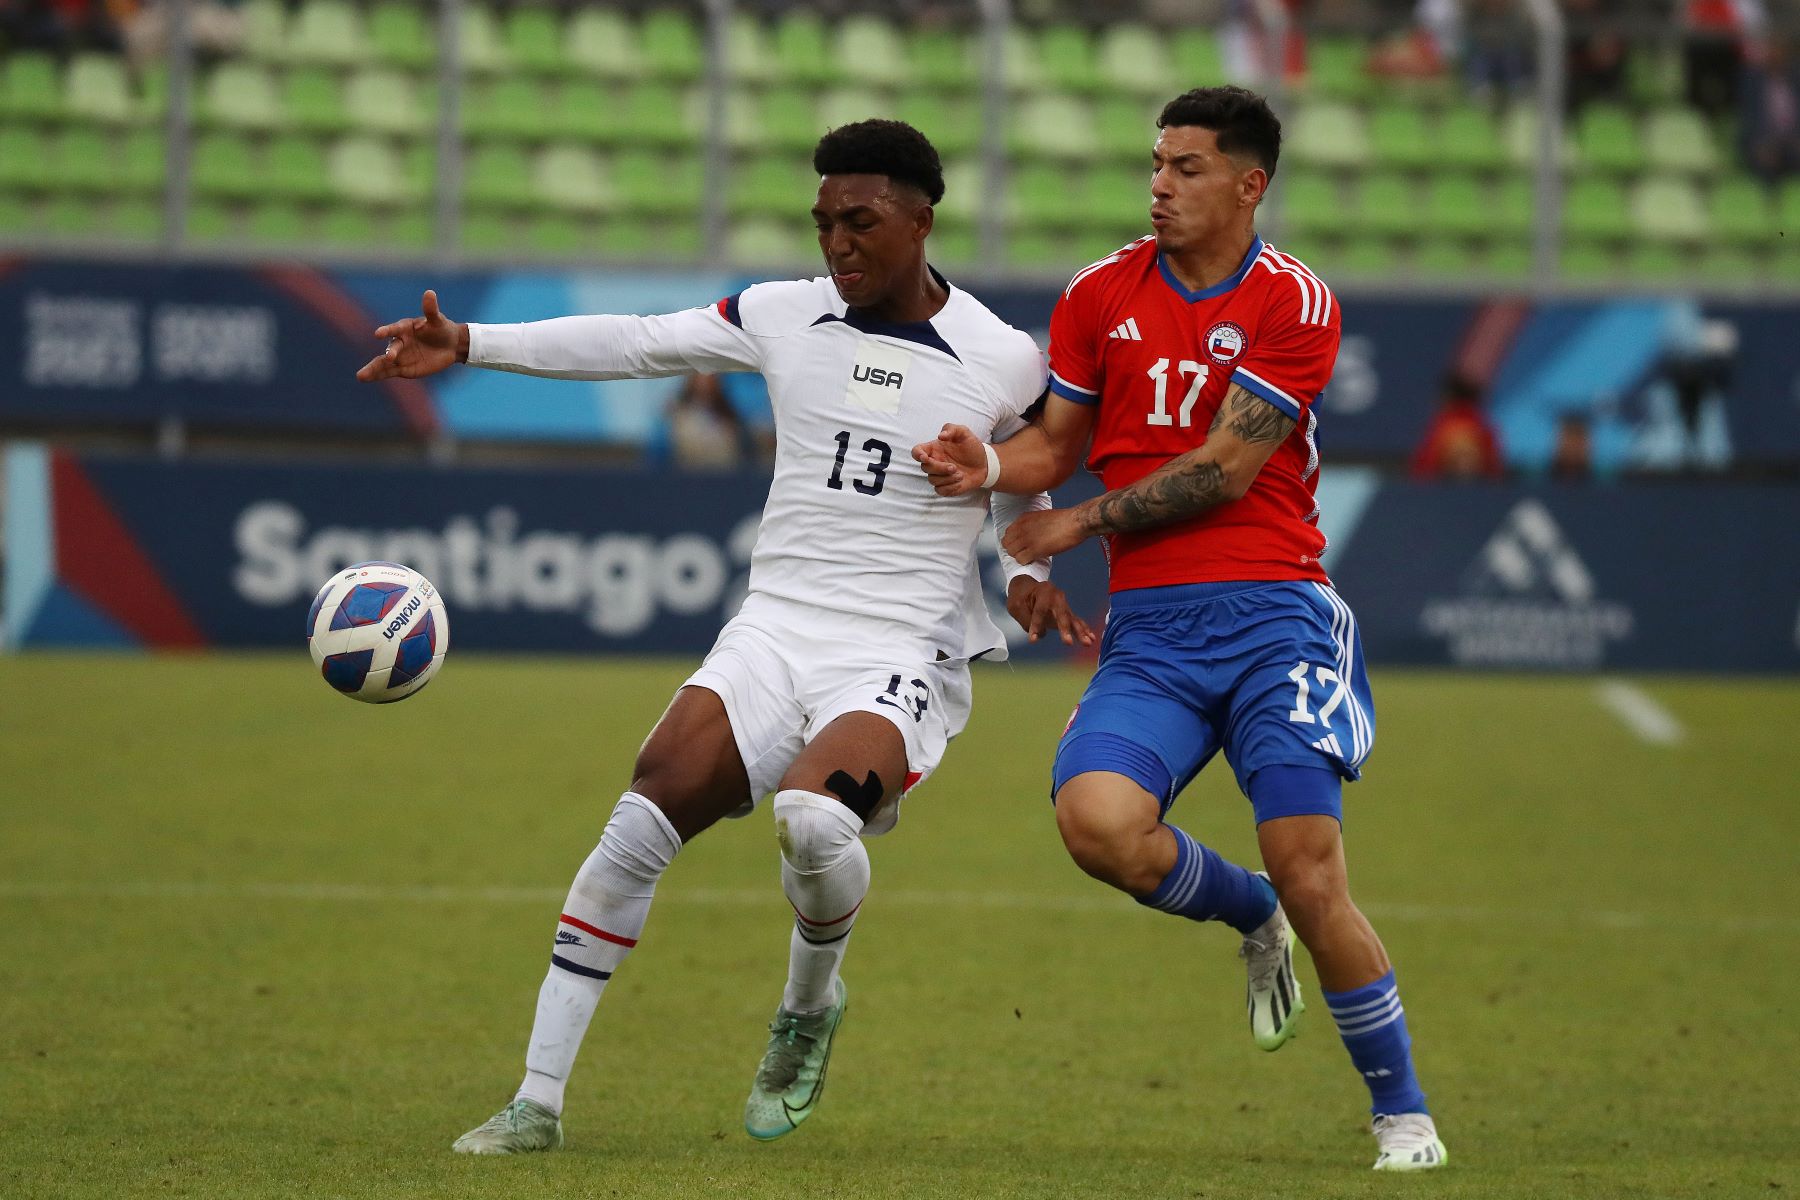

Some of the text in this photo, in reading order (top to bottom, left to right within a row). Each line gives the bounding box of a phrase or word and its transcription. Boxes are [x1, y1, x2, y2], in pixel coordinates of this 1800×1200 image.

[853, 365, 903, 389] USA
[1147, 357, 1208, 427] 17
[827, 431, 892, 496] 13
[234, 501, 724, 636] Santiago
[382, 596, 421, 640] molten
[884, 674, 930, 723] 13
[1288, 661, 1345, 728] 17
[558, 930, 581, 943] NIKE
